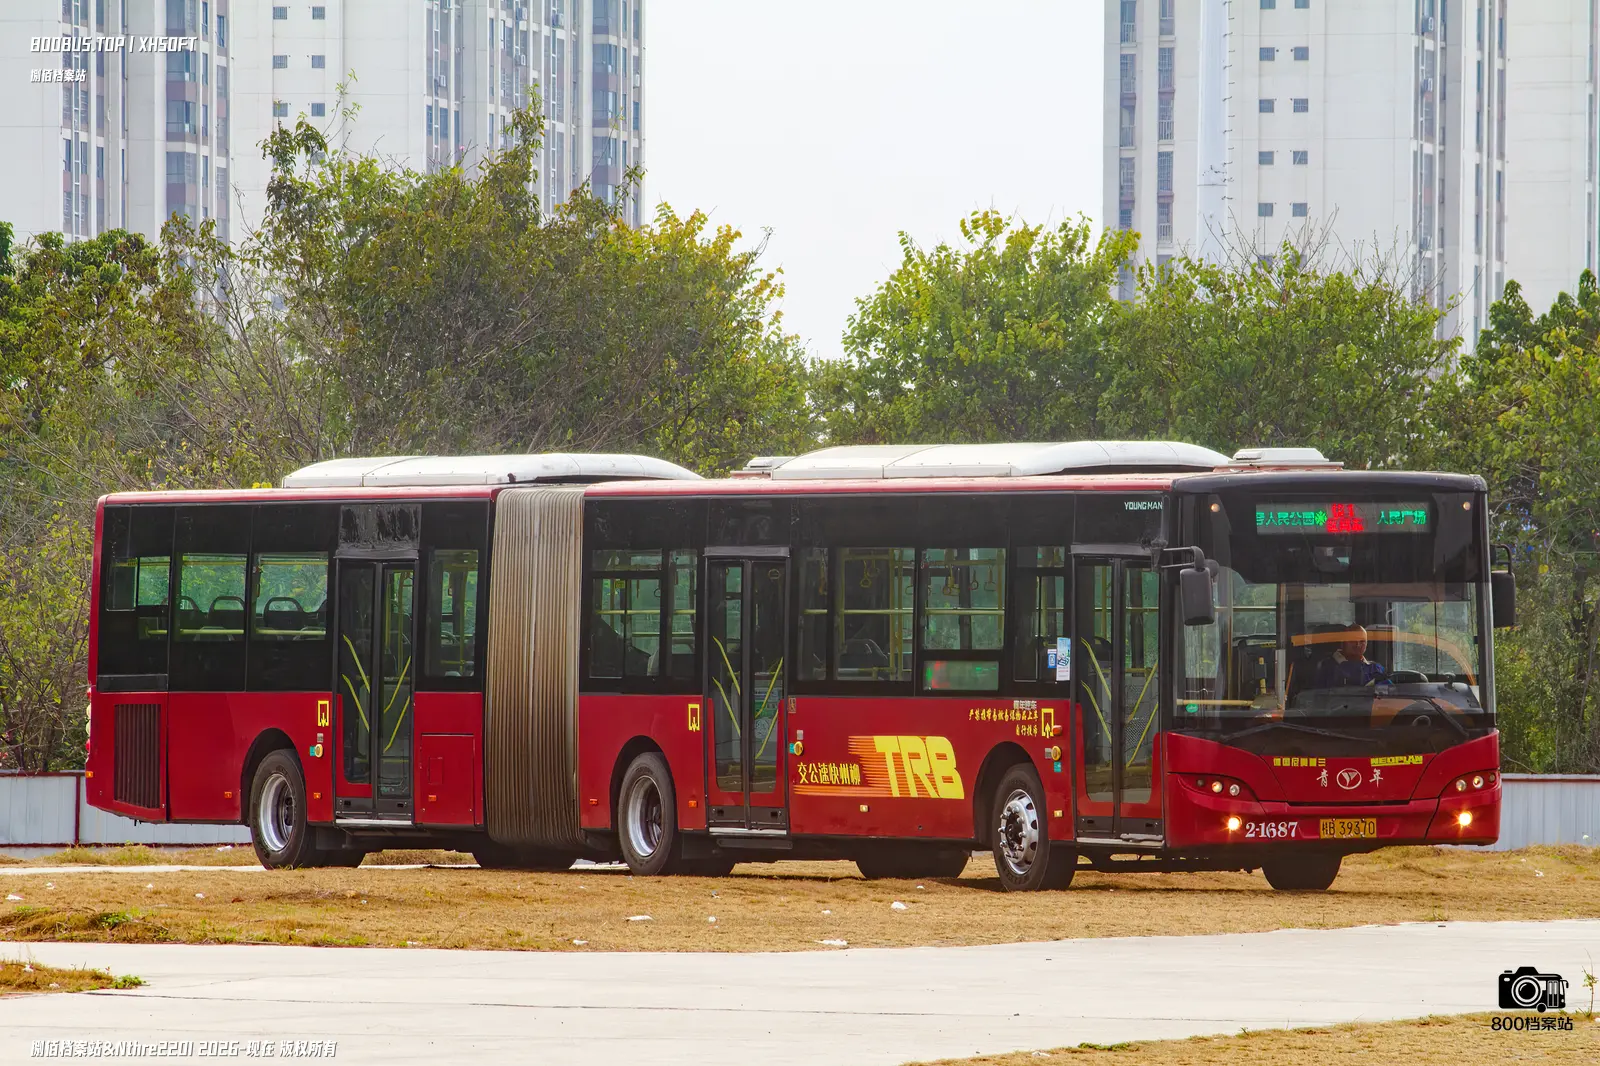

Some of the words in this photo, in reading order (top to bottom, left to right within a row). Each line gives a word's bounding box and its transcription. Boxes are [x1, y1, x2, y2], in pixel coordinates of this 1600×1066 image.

[1377, 509, 1427, 525] 人民广场
[1370, 755, 1423, 767] NEOPLAN
[1245, 821, 1298, 838] 2-1687
